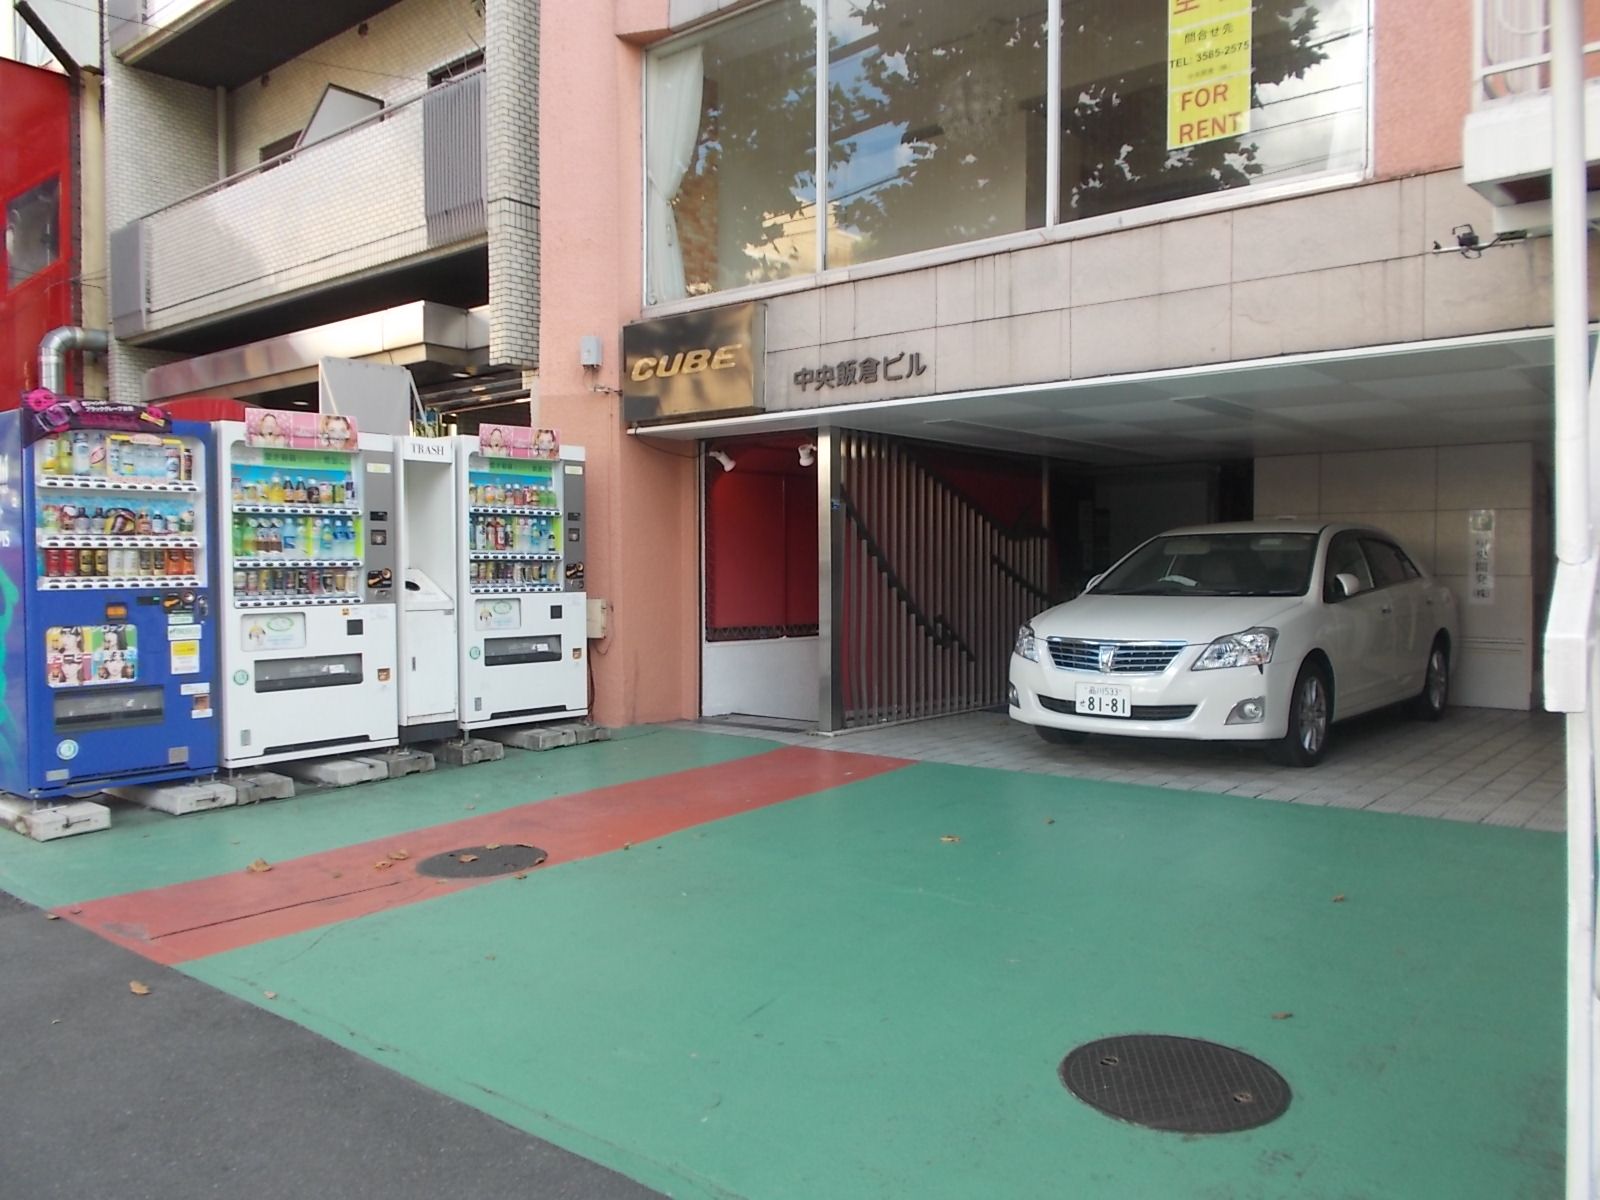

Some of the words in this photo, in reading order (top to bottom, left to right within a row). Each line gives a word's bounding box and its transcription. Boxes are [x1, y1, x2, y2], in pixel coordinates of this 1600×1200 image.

[1197, 41, 1250, 62] 3585-2575
[1181, 84, 1228, 111] FOR
[1179, 112, 1241, 143] RENT
[630, 343, 742, 382] CUBE
[793, 351, 928, 393] 中央飯倉ビル
[411, 443, 445, 457] TRASH
[1088, 696, 1126, 714] 81-81
